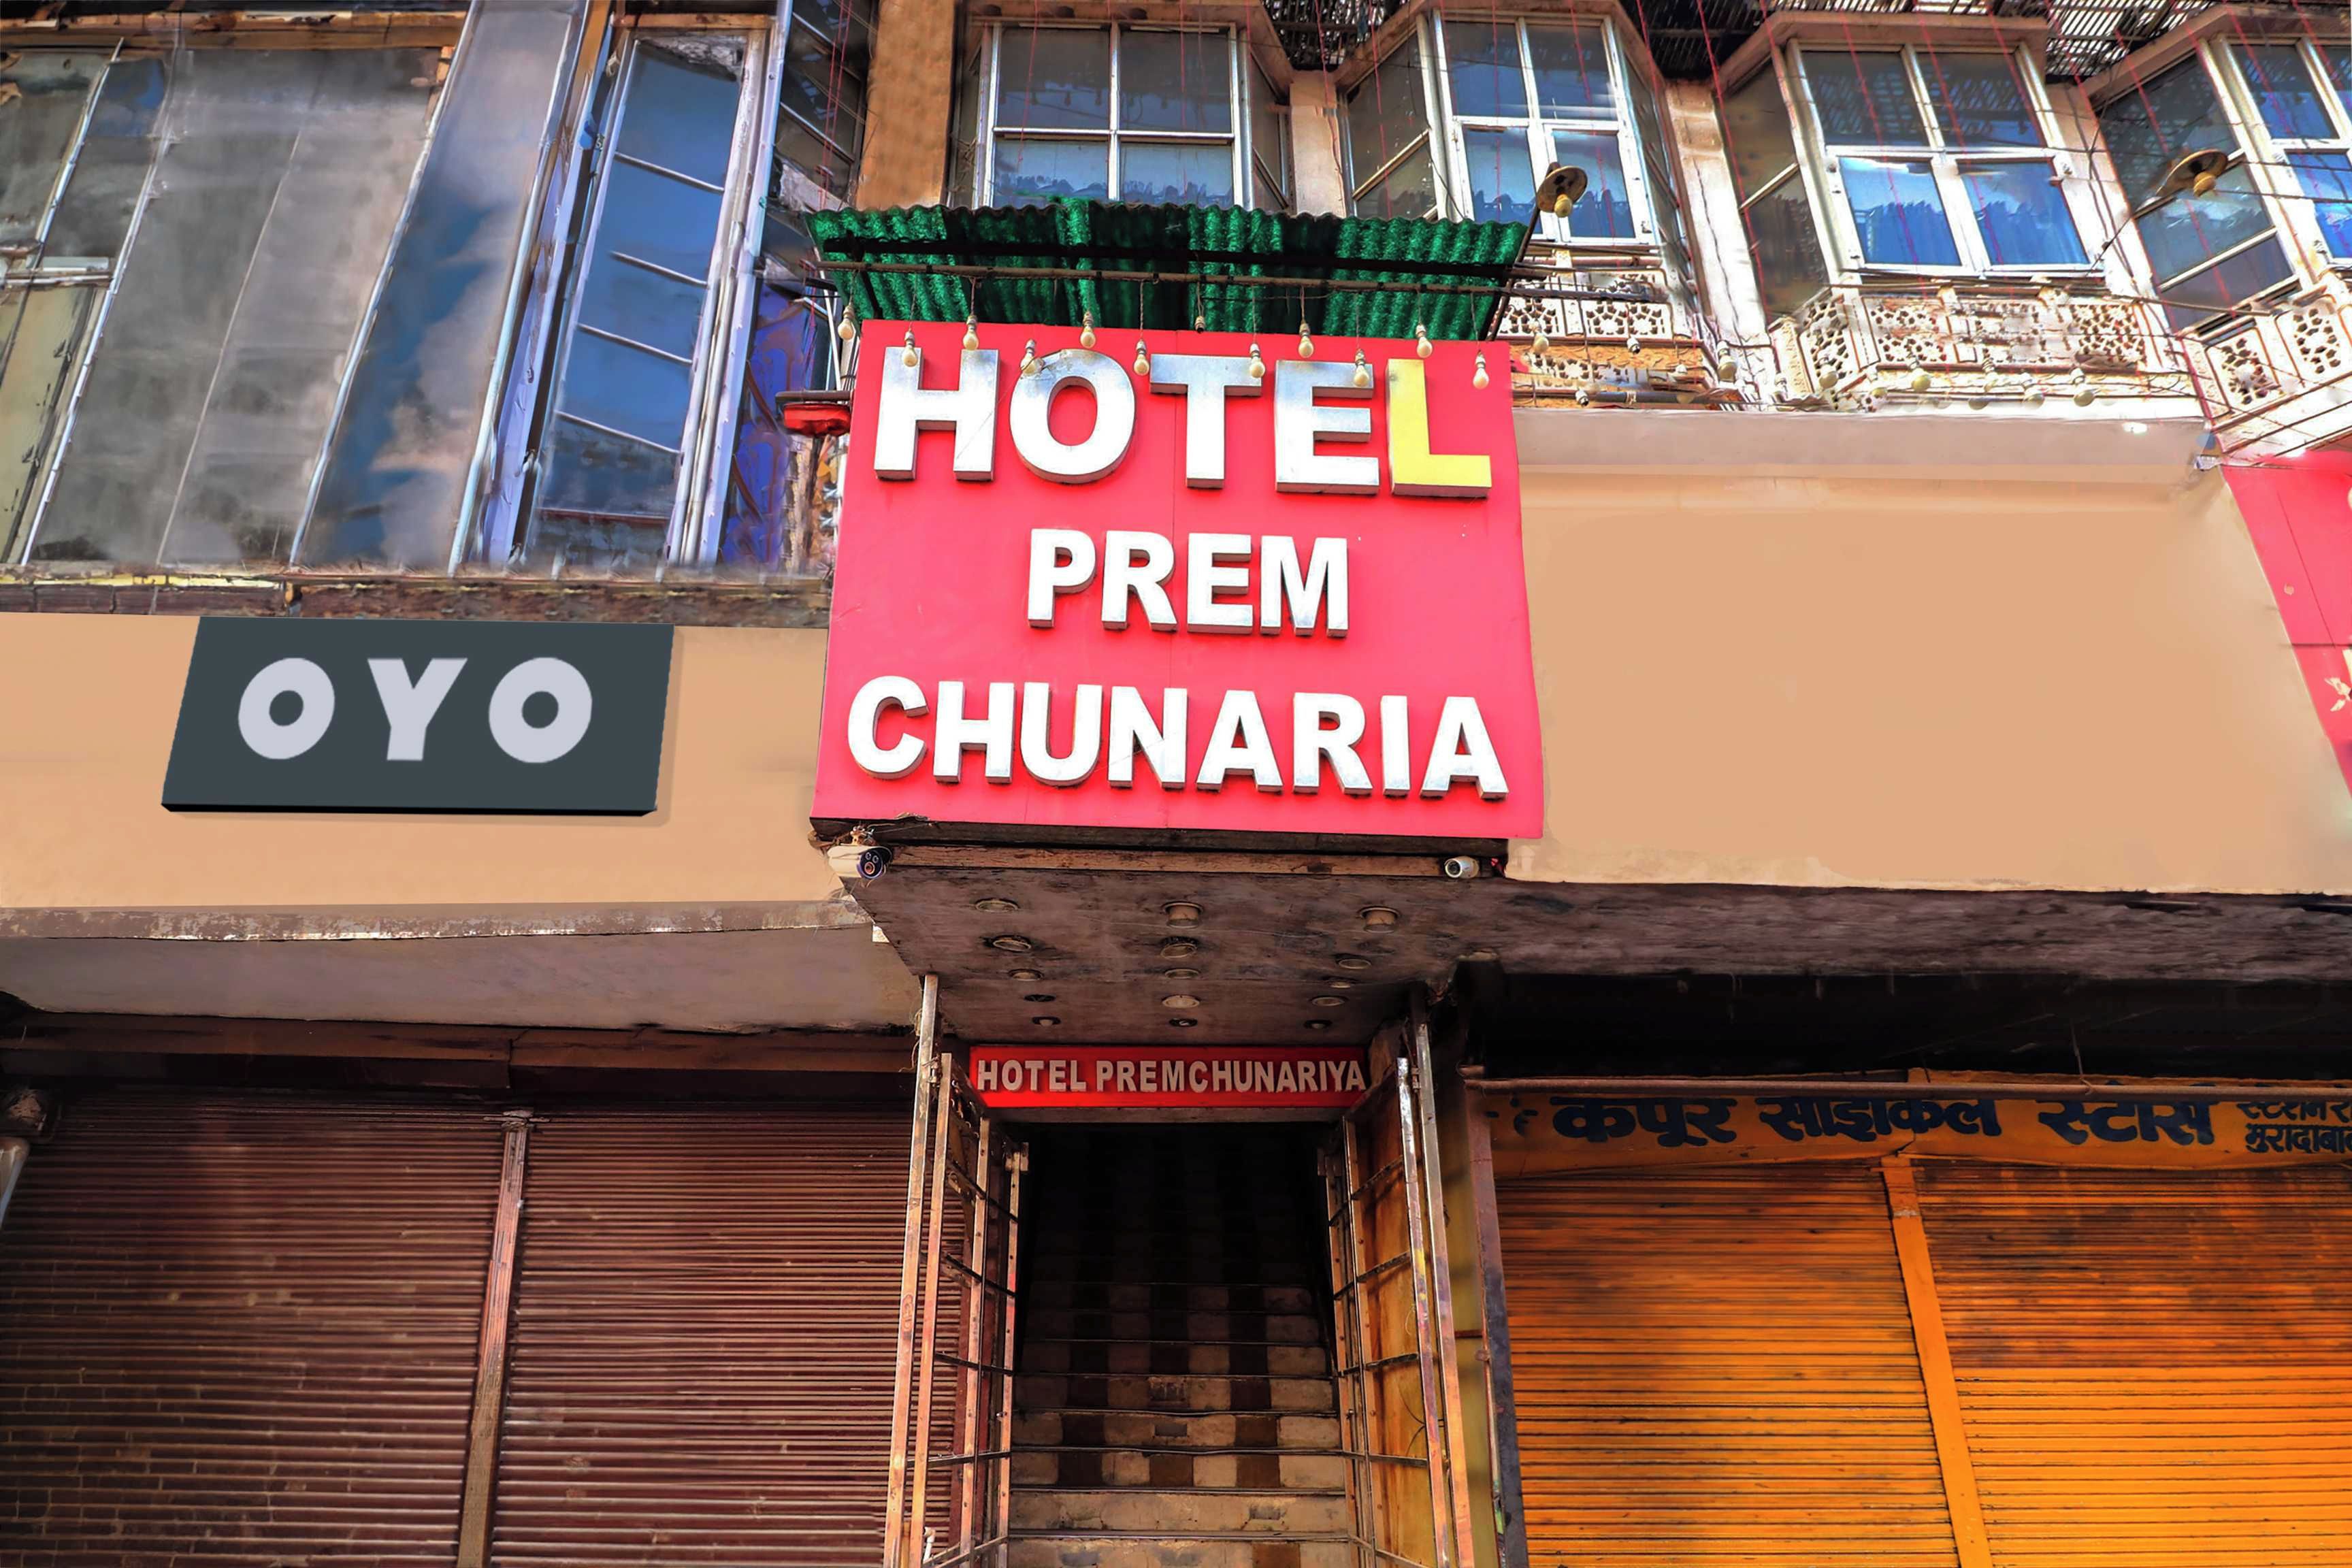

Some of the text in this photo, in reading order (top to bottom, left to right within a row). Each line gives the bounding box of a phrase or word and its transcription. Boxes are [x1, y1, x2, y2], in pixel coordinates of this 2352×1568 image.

[875, 346, 1492, 497] HOTEL
[1027, 528, 1350, 638] PREM
[238, 657, 592, 763] OYO
[847, 675, 1509, 800] CHUNARIA
[977, 1060, 1086, 1092] HOTEL
[1550, 1097, 1737, 1147] कपूर
